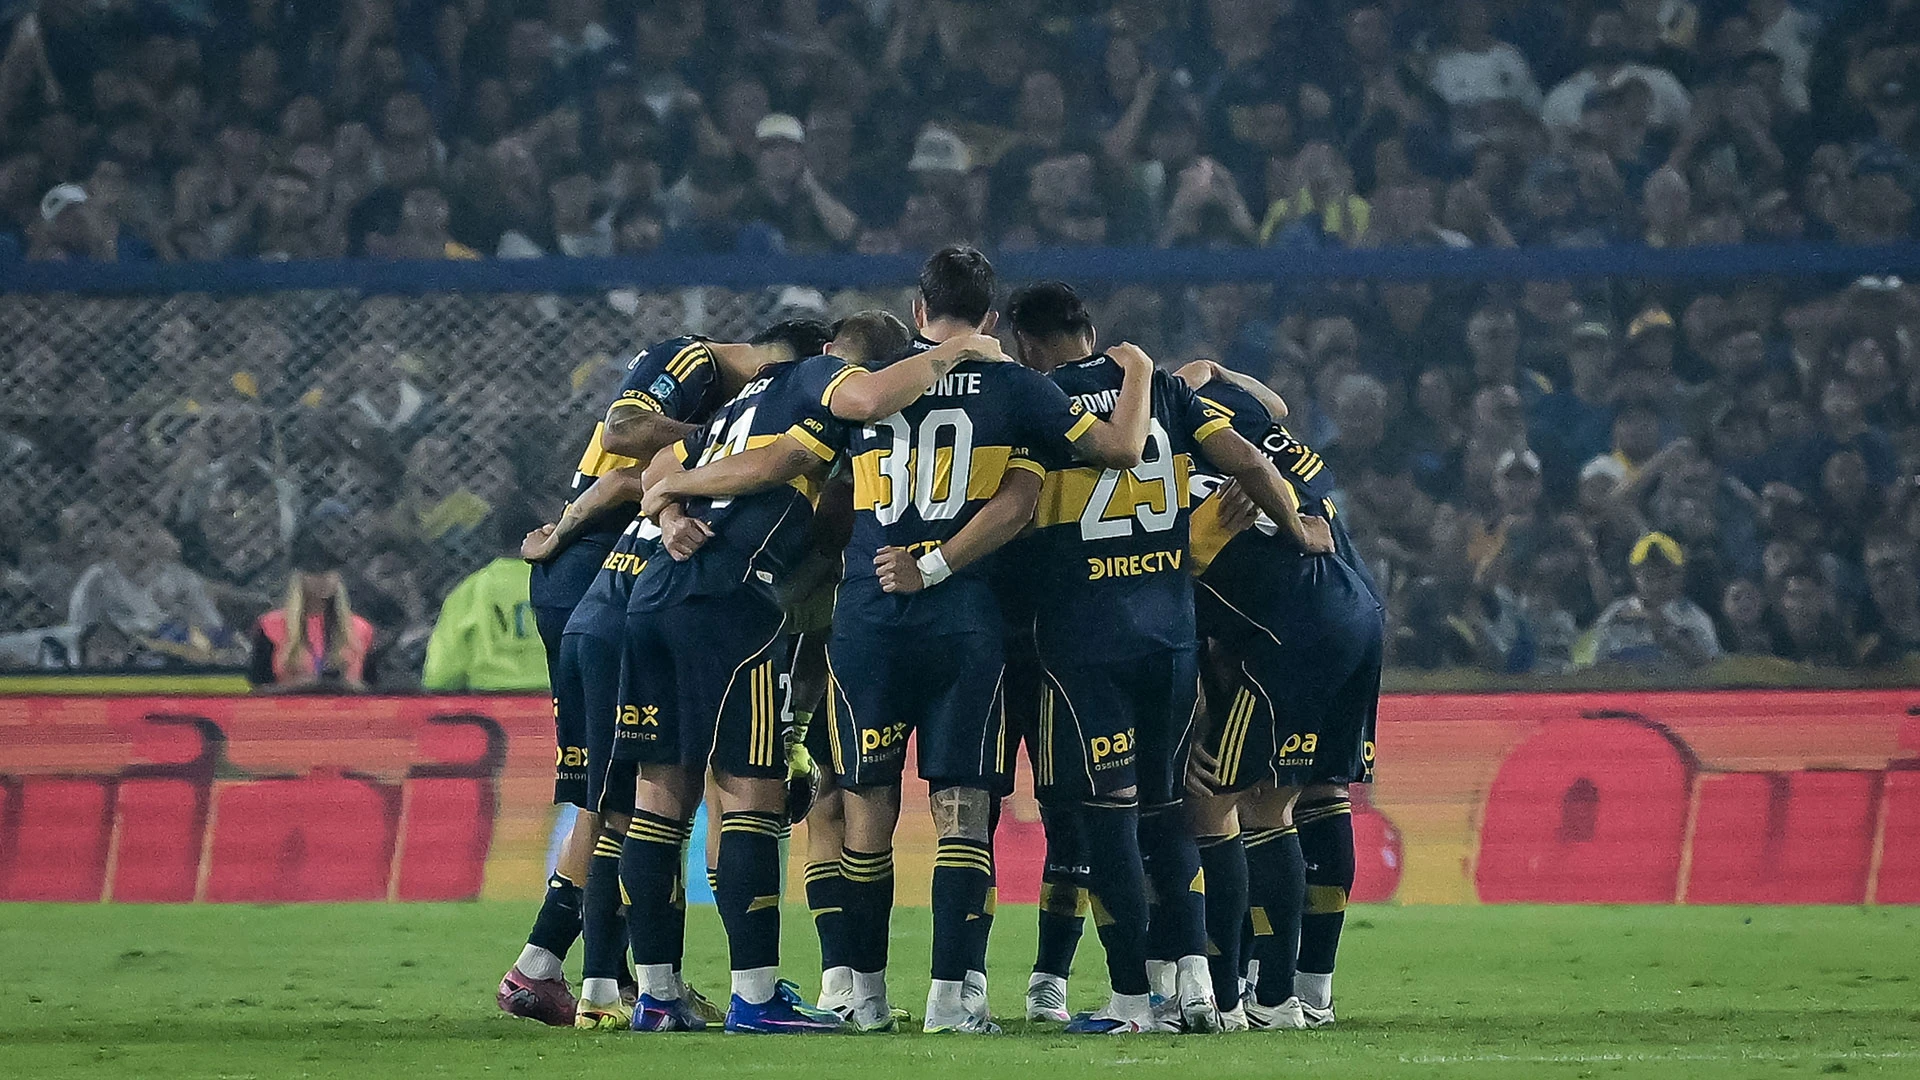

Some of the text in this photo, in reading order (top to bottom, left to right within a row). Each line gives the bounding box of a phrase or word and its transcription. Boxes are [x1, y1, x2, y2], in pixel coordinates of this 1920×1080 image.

[862, 407, 974, 527] 30
[1080, 418, 1178, 541] 29
[1087, 549, 1182, 580] DIRECTV
[862, 722, 907, 755] pax
